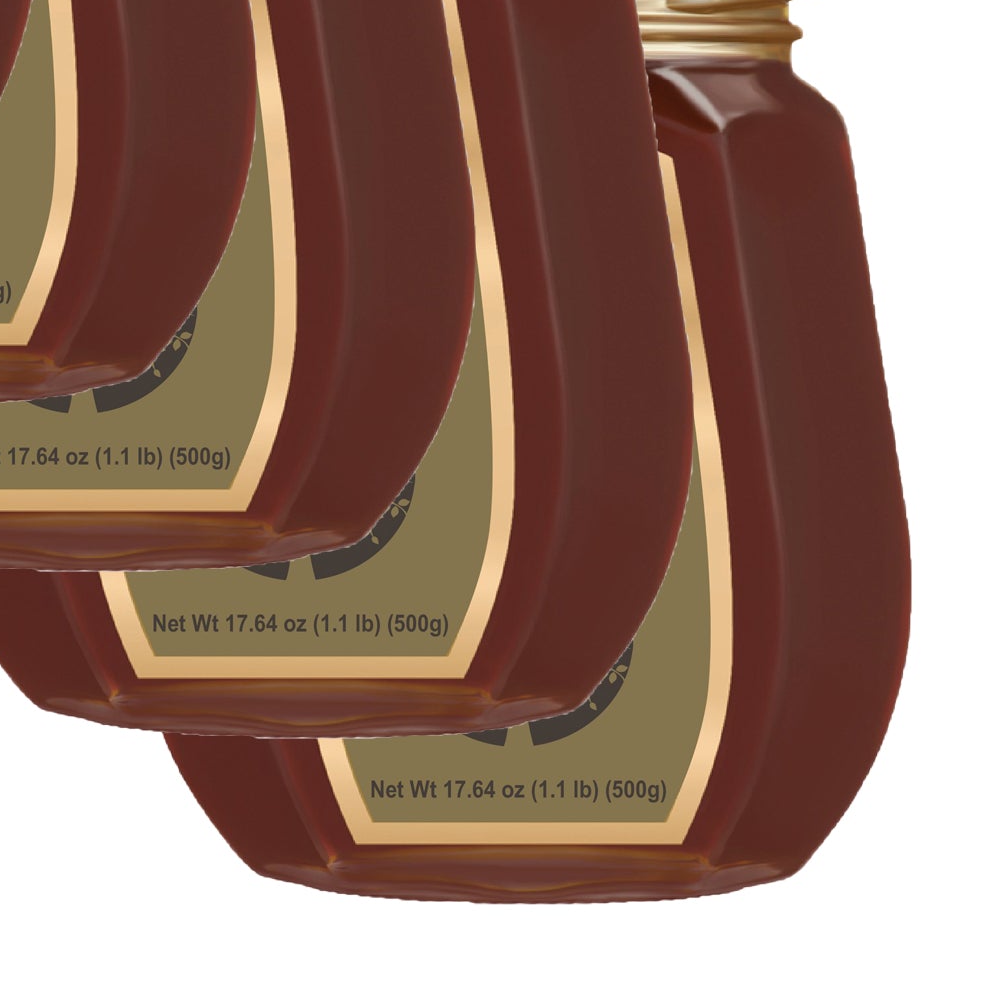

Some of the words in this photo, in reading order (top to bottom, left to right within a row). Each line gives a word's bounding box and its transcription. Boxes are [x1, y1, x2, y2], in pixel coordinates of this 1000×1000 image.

[7, 446, 60, 466] 17.64
[65, 451, 89, 466] oz
[95, 446, 129, 471] (1.1
[137, 446, 163, 471] lb)
[169, 446, 231, 471] (500g)
[152, 613, 187, 633] Net
[191, 613, 220, 633] Wt
[225, 613, 278, 633] 17.64
[283, 618, 308, 633] oz
[313, 613, 347, 638] (1.1
[355, 613, 381, 638] lb)
[387, 613, 449, 638] (500g)
[370, 779, 405, 799] Net
[409, 779, 438, 799] Wt
[443, 779, 496, 799] 17.64
[501, 784, 526, 799] oz
[531, 779, 565, 804] (1.1
[573, 779, 599, 804] lb)
[605, 779, 667, 804] (500g)
